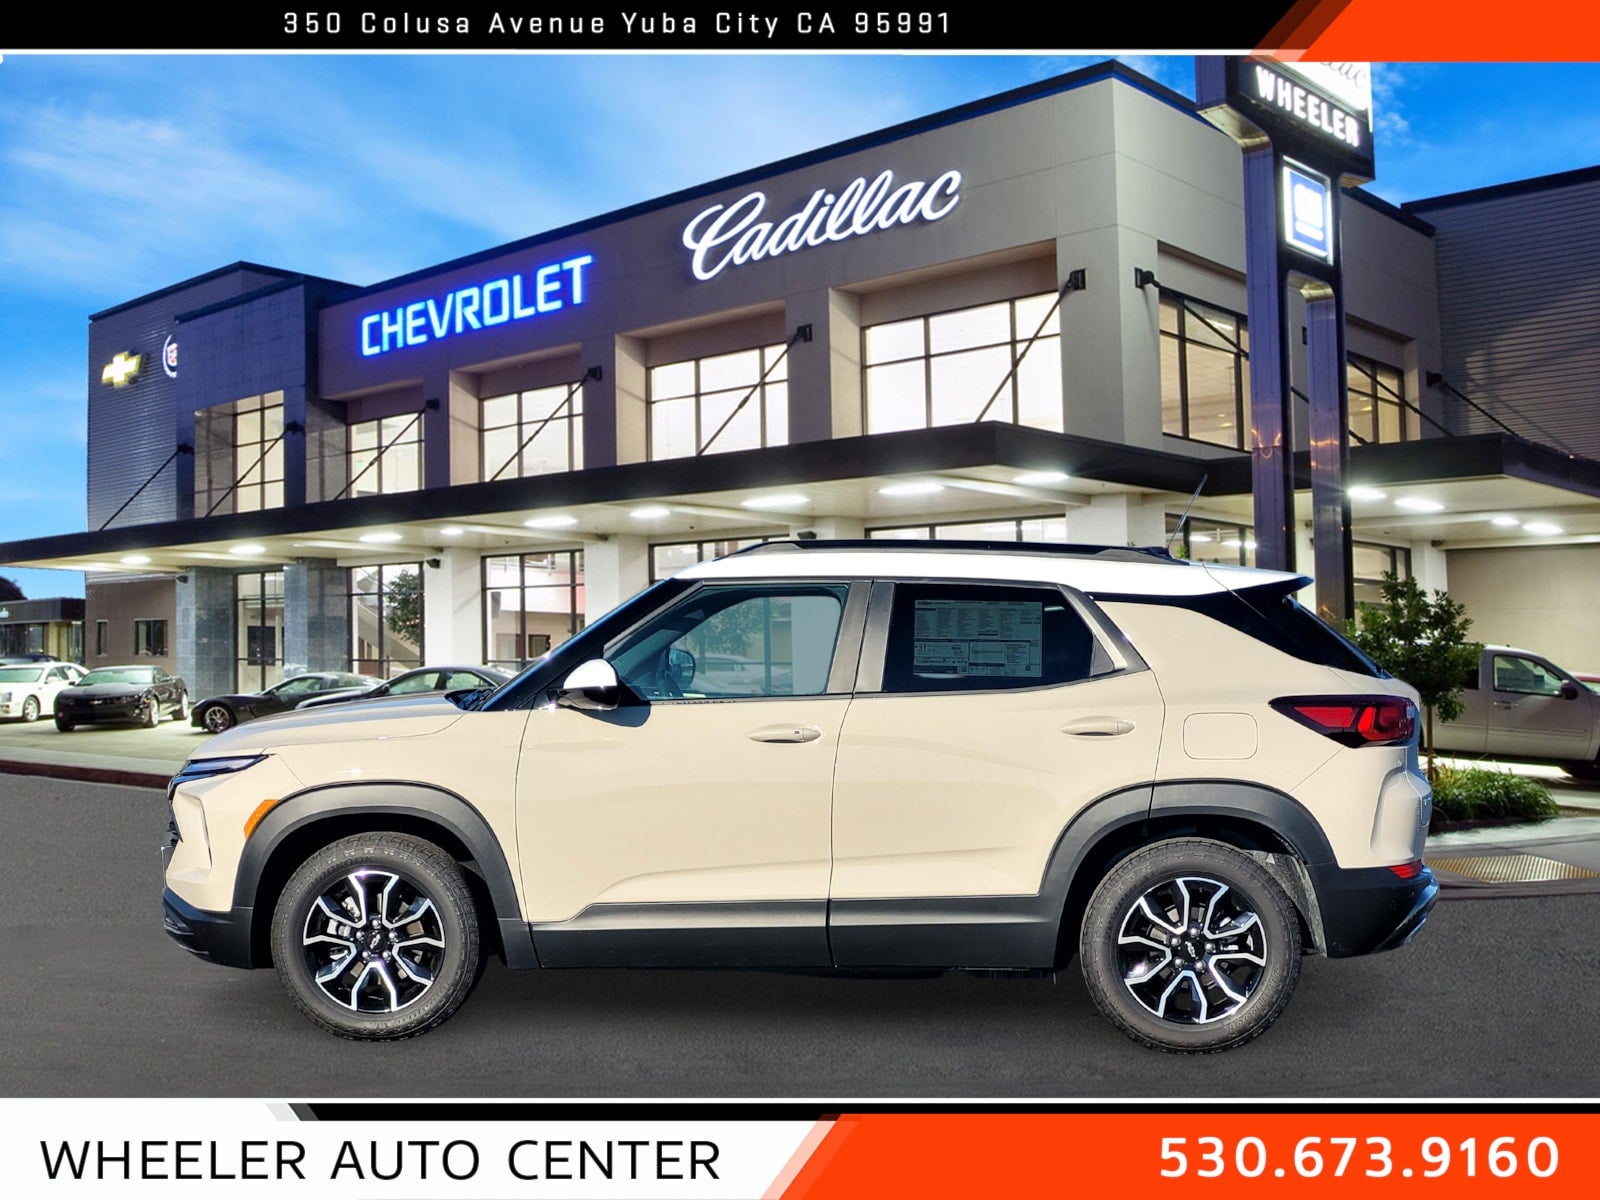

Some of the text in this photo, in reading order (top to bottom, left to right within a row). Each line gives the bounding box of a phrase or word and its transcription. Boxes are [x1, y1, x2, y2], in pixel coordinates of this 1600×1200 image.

[1255, 65, 1359, 147] WHEELER
[682, 169, 962, 281] Cadillac
[361, 254, 593, 357] CHEVROLET
